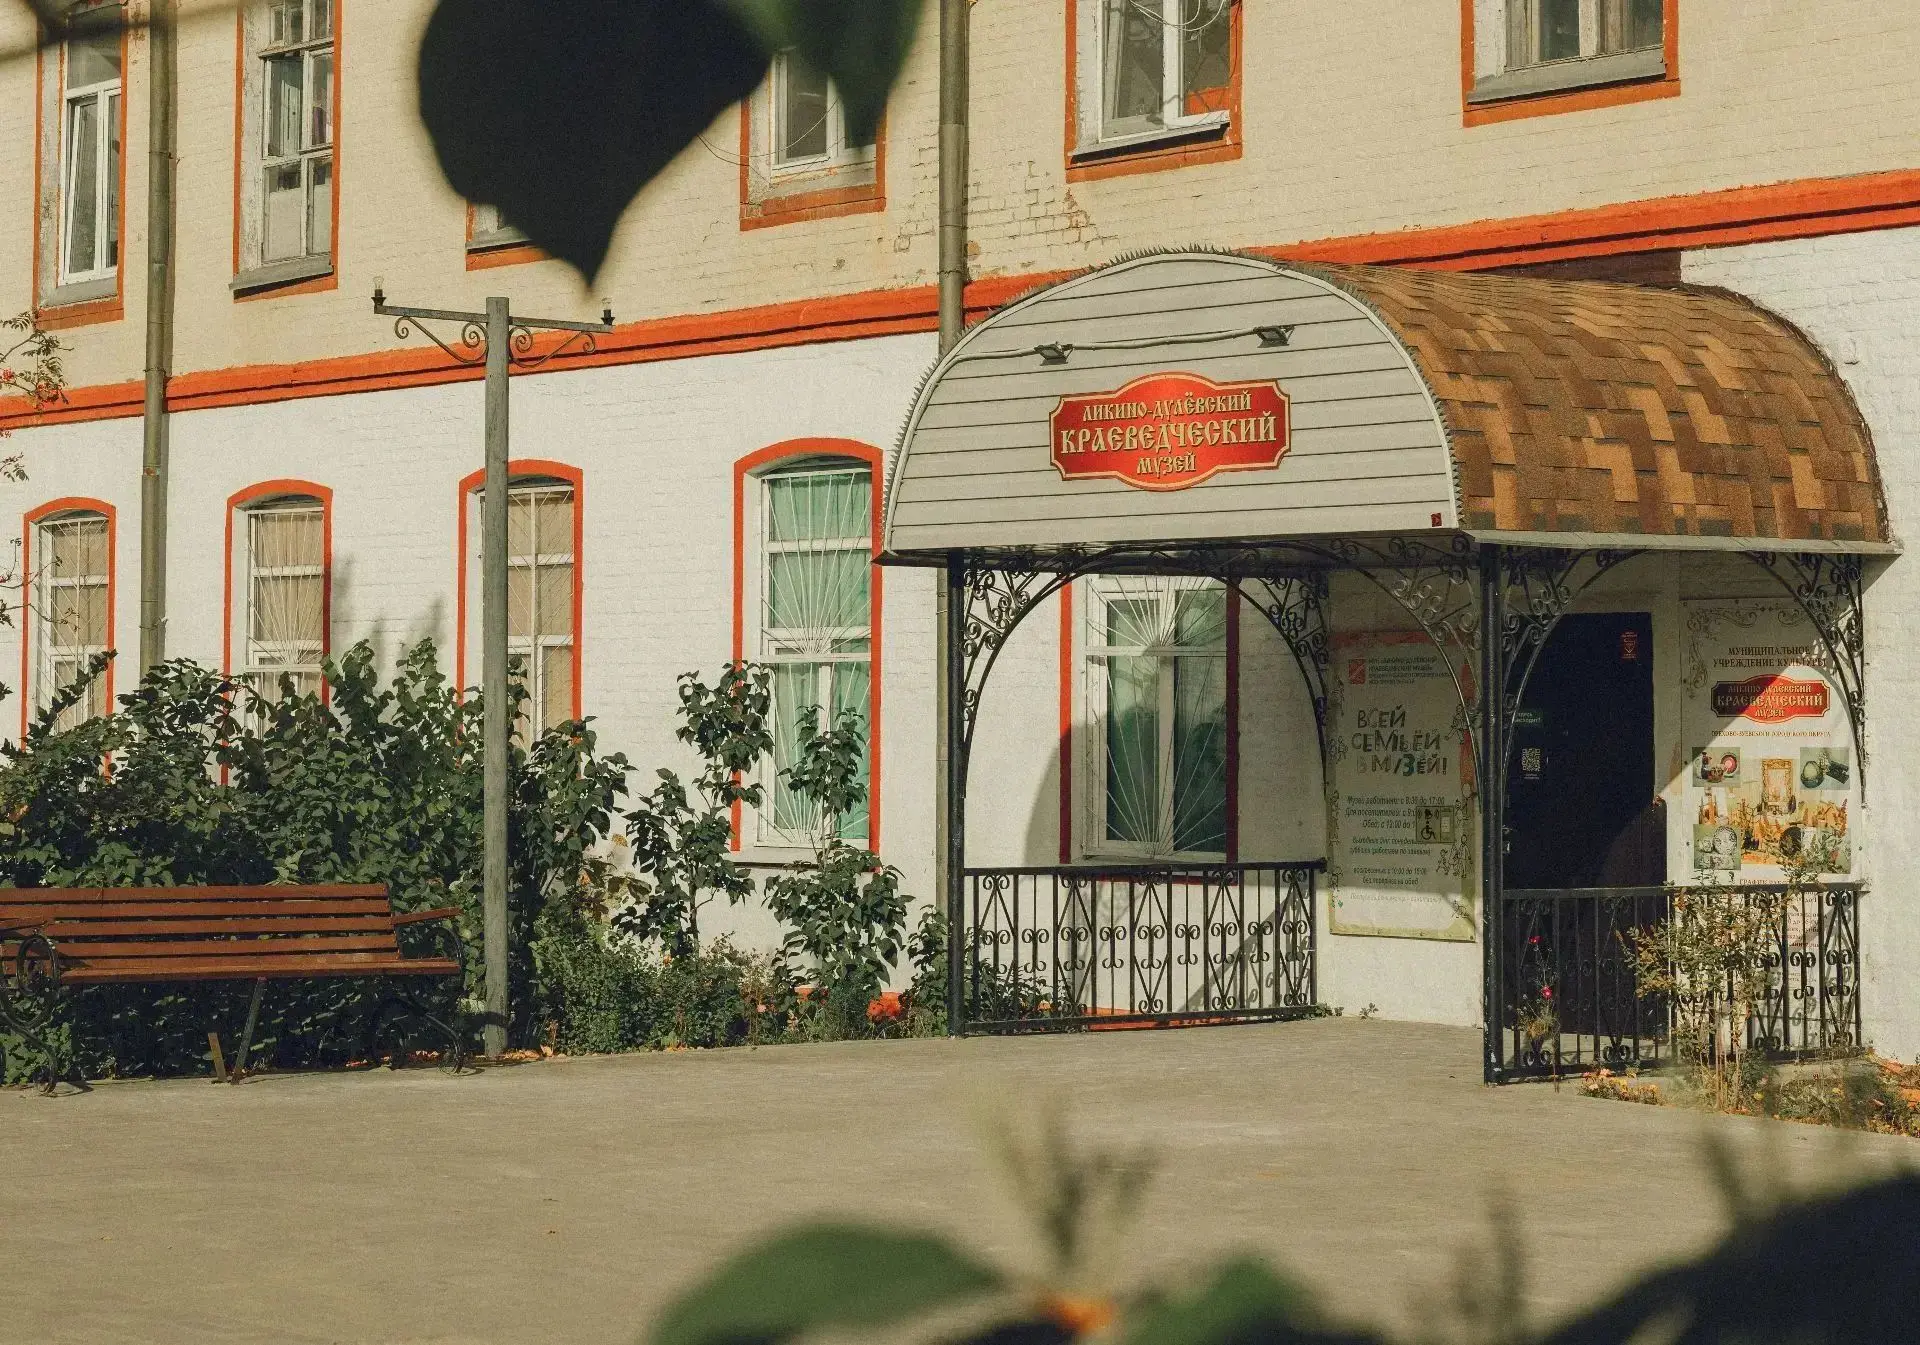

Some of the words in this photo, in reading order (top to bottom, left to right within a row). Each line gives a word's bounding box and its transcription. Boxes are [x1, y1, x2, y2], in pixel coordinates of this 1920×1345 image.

[1082, 390, 1252, 422] ЛИКИНО-ДУЛЁВСКИЙ
[1060, 410, 1278, 454] КРАЕВЕДЧЕСКИЙ
[1136, 452, 1197, 478] МУЗЕЙ
[1712, 658, 1775, 668] УЧРЕЖДЕНИЕ
[1777, 658, 1827, 667] КУЛЬТУРЫ
[1727, 646, 1811, 656] МУНИЦИПАЛЬНОЕ
[1717, 694, 1823, 709] КРАЕВЕДЧЕСКИЙ
[1357, 704, 1406, 729] ВСЕЙ
